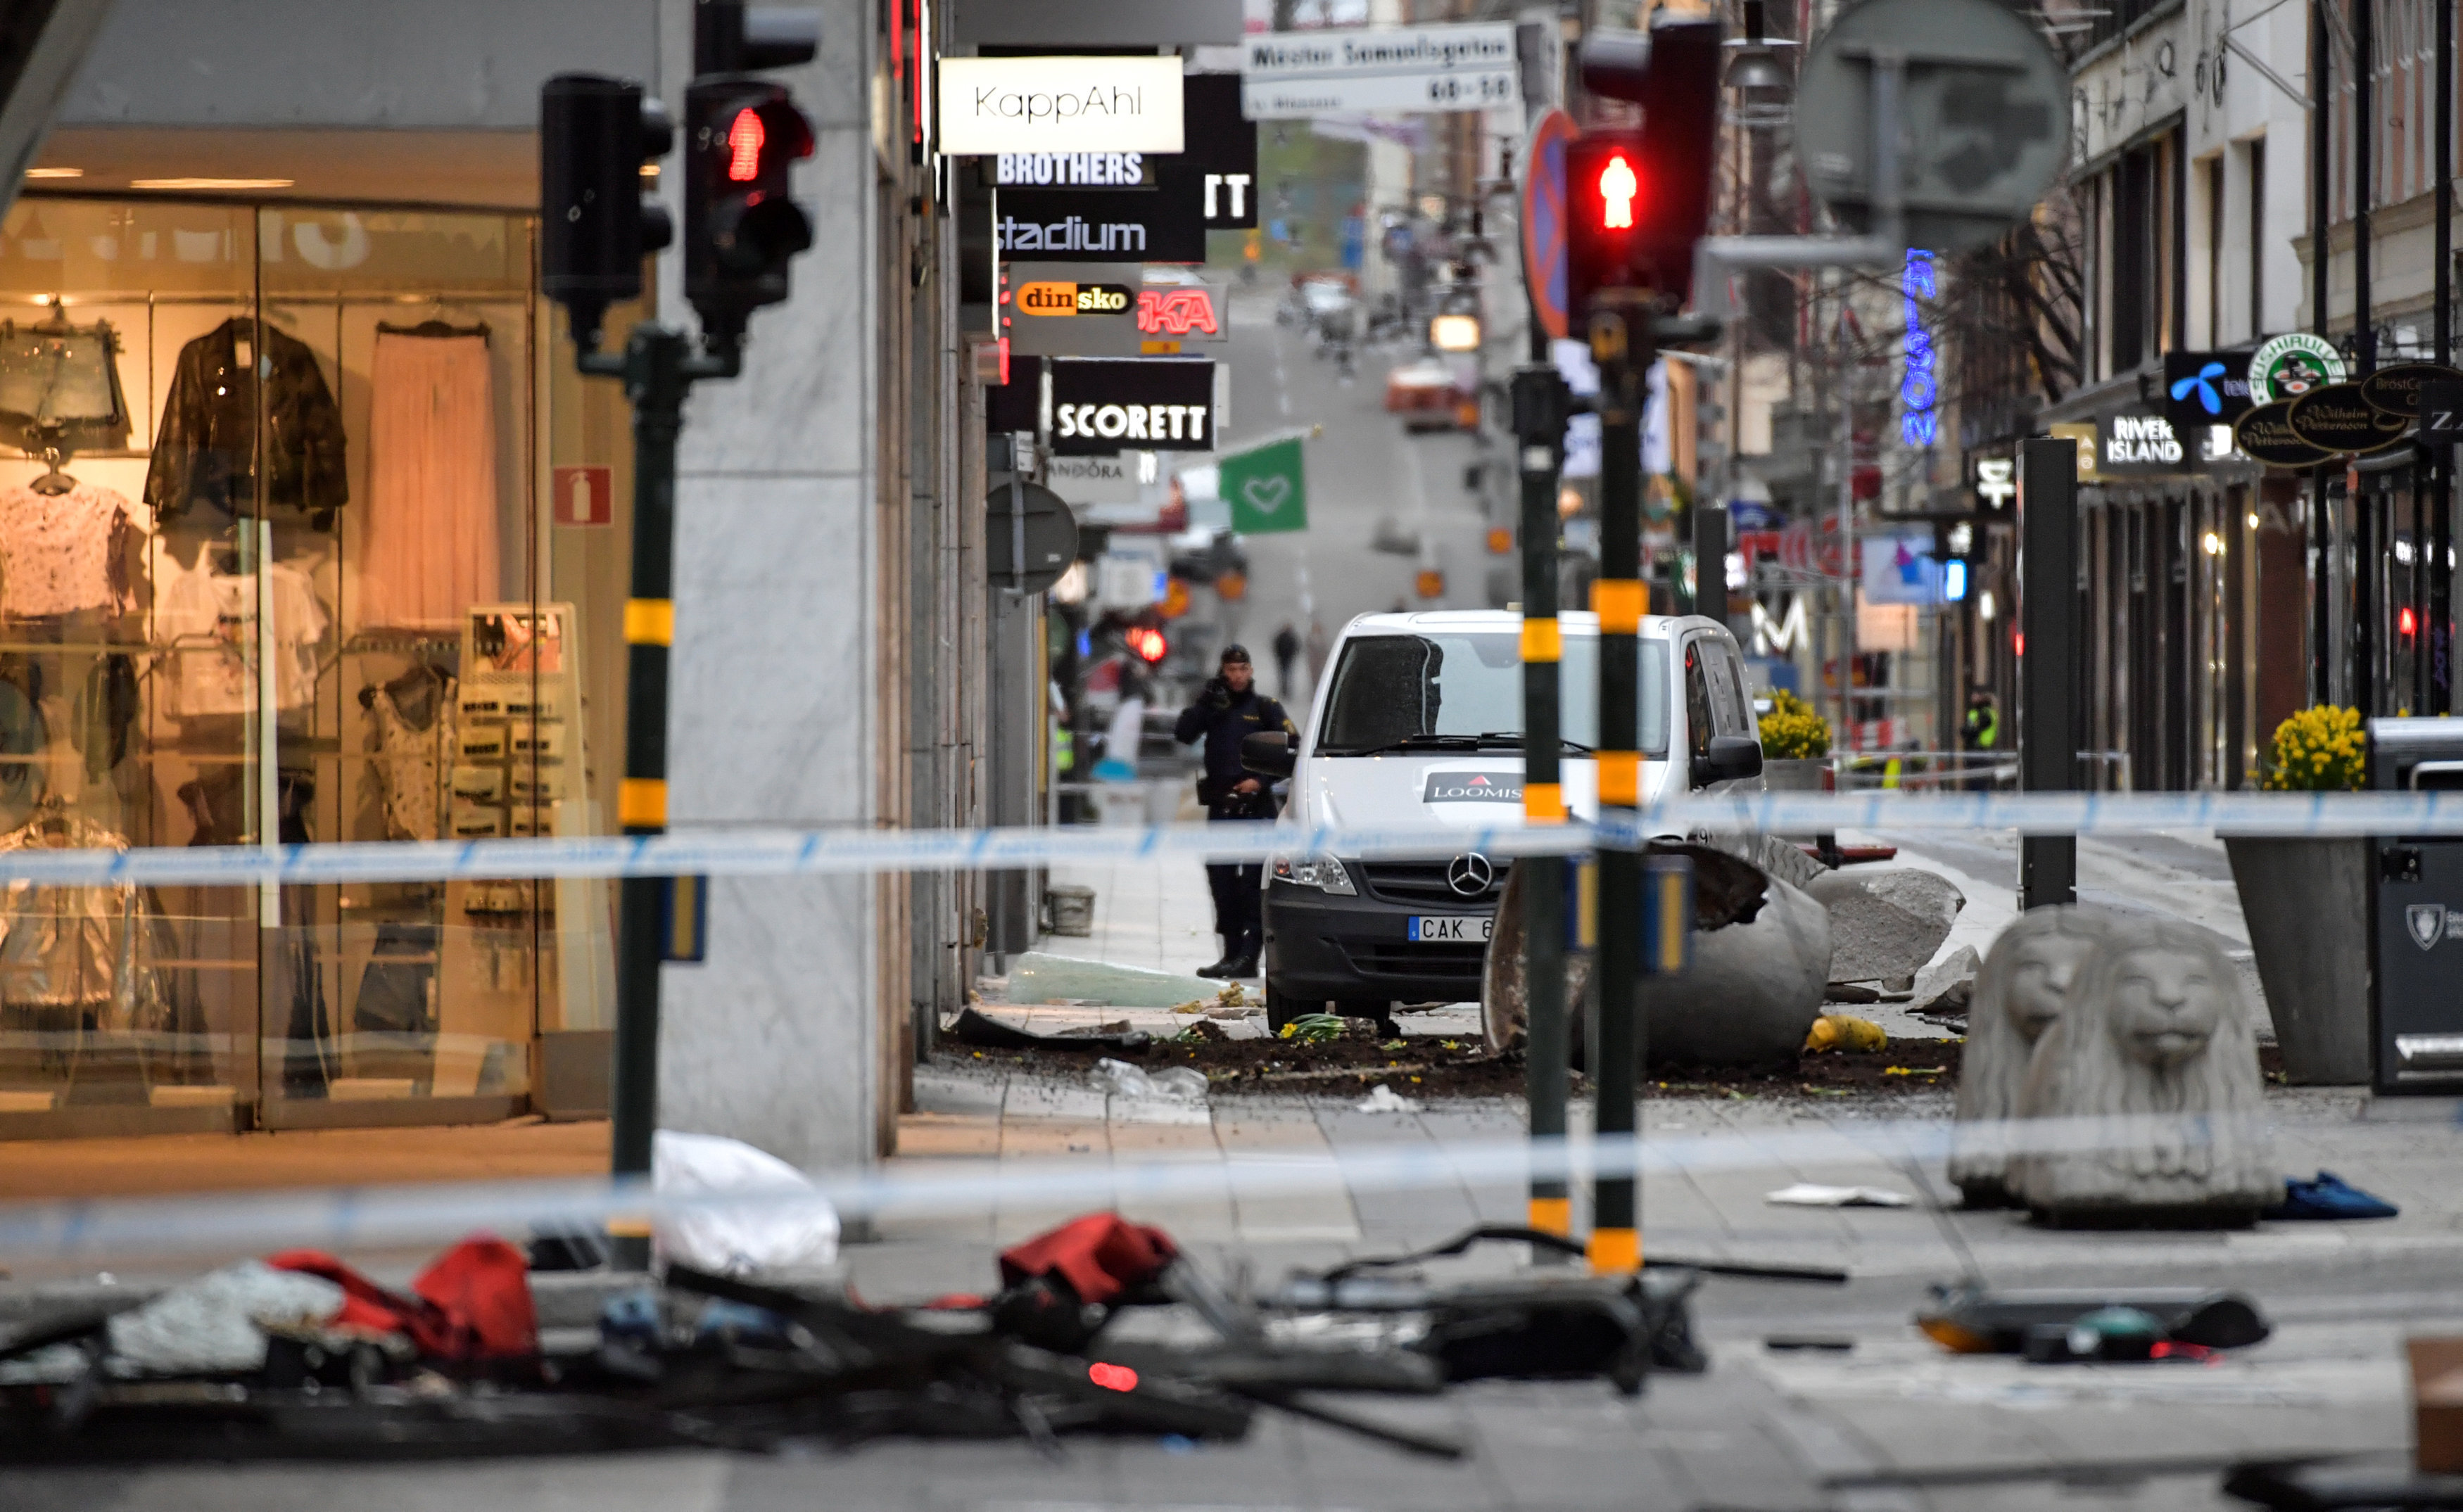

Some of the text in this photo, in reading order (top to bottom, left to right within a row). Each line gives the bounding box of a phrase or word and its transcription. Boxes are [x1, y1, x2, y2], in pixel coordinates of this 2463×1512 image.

[976, 86, 1141, 125] KappAhl
[996, 153, 1143, 185] BROTHERS
[1025, 287, 1127, 310] dinsko
[1057, 402, 1206, 441] SCORETT
[2113, 416, 2174, 440] RIVER
[2431, 411, 2463, 431] Z
[2107, 438, 2182, 463] ISLAND
[1433, 786, 1524, 799] LOOMIS
[1423, 919, 1463, 939] CAK
